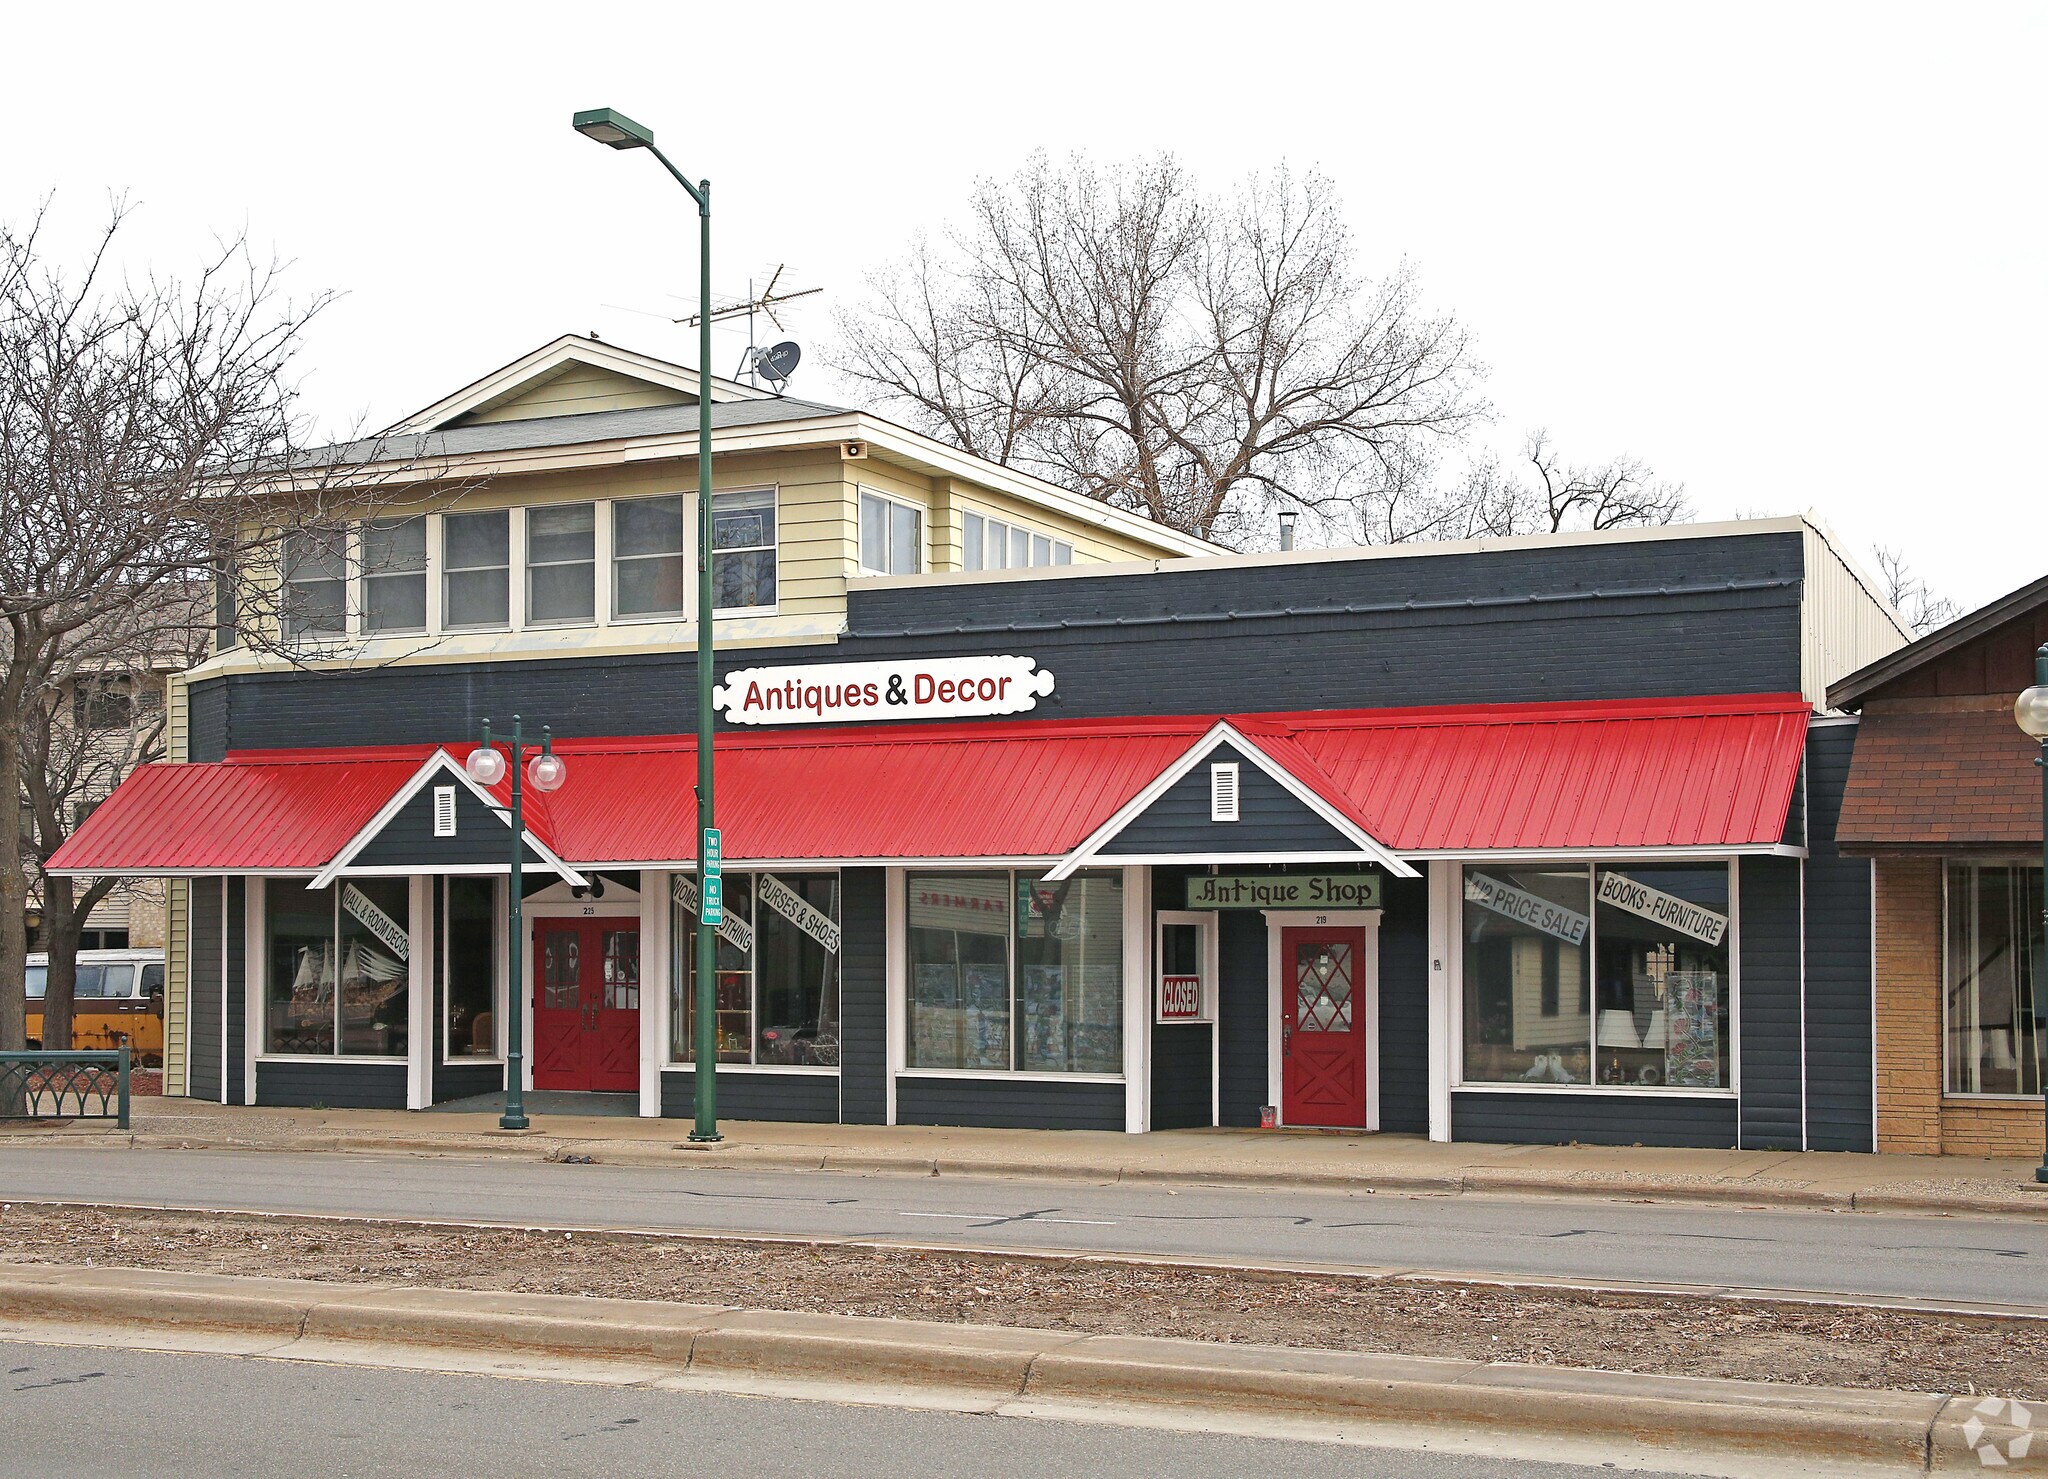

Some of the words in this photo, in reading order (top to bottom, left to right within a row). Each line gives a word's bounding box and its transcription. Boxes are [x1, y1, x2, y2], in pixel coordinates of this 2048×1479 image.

[743, 679, 878, 716] Antiques
[885, 674, 908, 705] &
[914, 674, 1012, 705] Decor
[706, 849, 719, 858] HOUR
[707, 837, 718, 846] TWO
[706, 860, 720, 869] PARKING
[673, 878, 698, 911] WOME
[706, 896, 720, 906] TRUCK
[709, 885, 717, 894] NO
[1195, 877, 1299, 906] Antique
[1308, 877, 1372, 906] Shop
[343, 887, 363, 914] WALL
[360, 904, 369, 920] &
[365, 909, 390, 938] ROOM
[705, 908, 721, 917] PARKING
[759, 878, 799, 918] PURSES
[796, 908, 808, 924] &
[805, 915, 840, 951] SHOES
[1315, 915, 1327, 924] 219
[1494, 889, 1543, 924] PRICE
[1541, 908, 1584, 941] SALE
[1602, 877, 1647, 910] BOOKS
[1651, 896, 1722, 940] FURNITURE
[1163, 981, 1198, 1013] CLOSED
